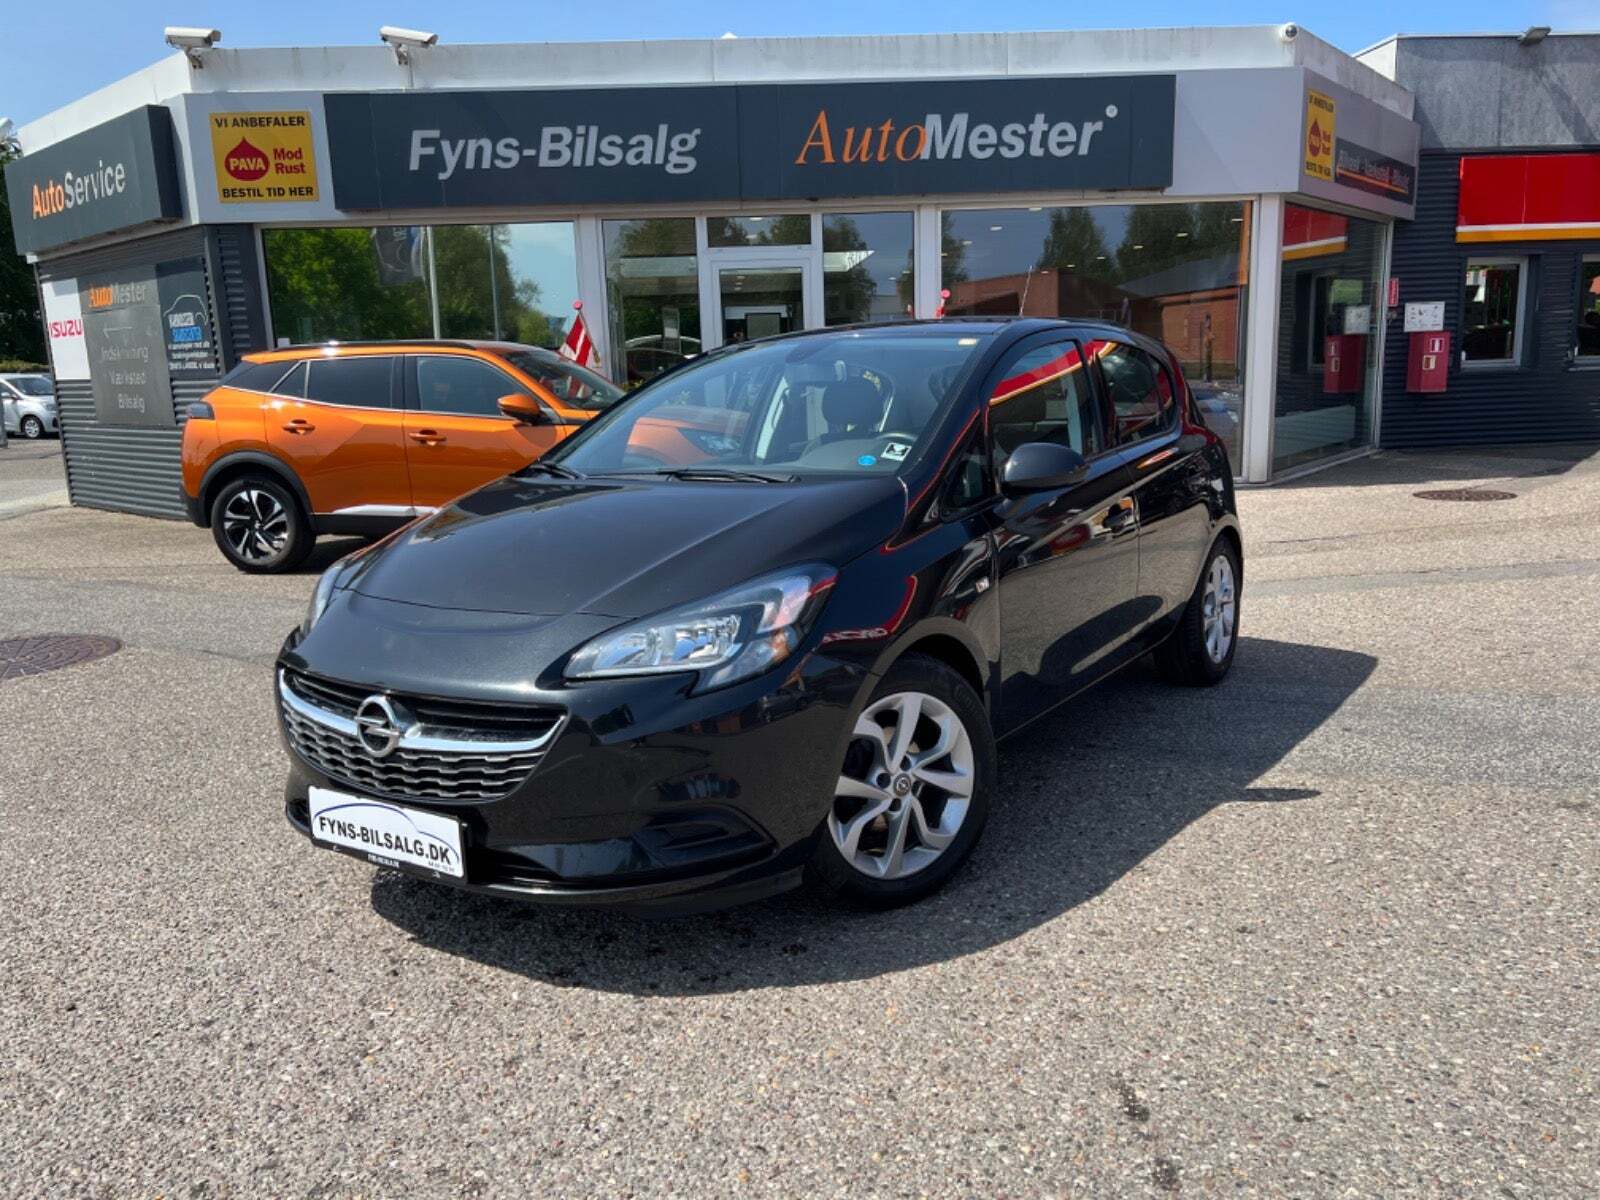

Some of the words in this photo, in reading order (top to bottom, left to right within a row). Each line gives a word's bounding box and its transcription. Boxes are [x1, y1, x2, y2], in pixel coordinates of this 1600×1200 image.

[215, 118, 228, 128] VI
[232, 116, 305, 128] ANBEFALER
[795, 109, 1104, 165] AutoMester
[273, 147, 303, 160] Mod
[409, 124, 701, 180] Fyns-Bilsalg
[229, 157, 266, 171] PAVA
[275, 162, 306, 174] Rust
[32, 160, 126, 220] AutoService
[222, 187, 264, 198] BESTIL
[267, 187, 285, 197] TID
[289, 186, 314, 197] HER
[49, 319, 84, 338] ISUZU
[319, 816, 452, 865] FYNS-BILSALG.DK
